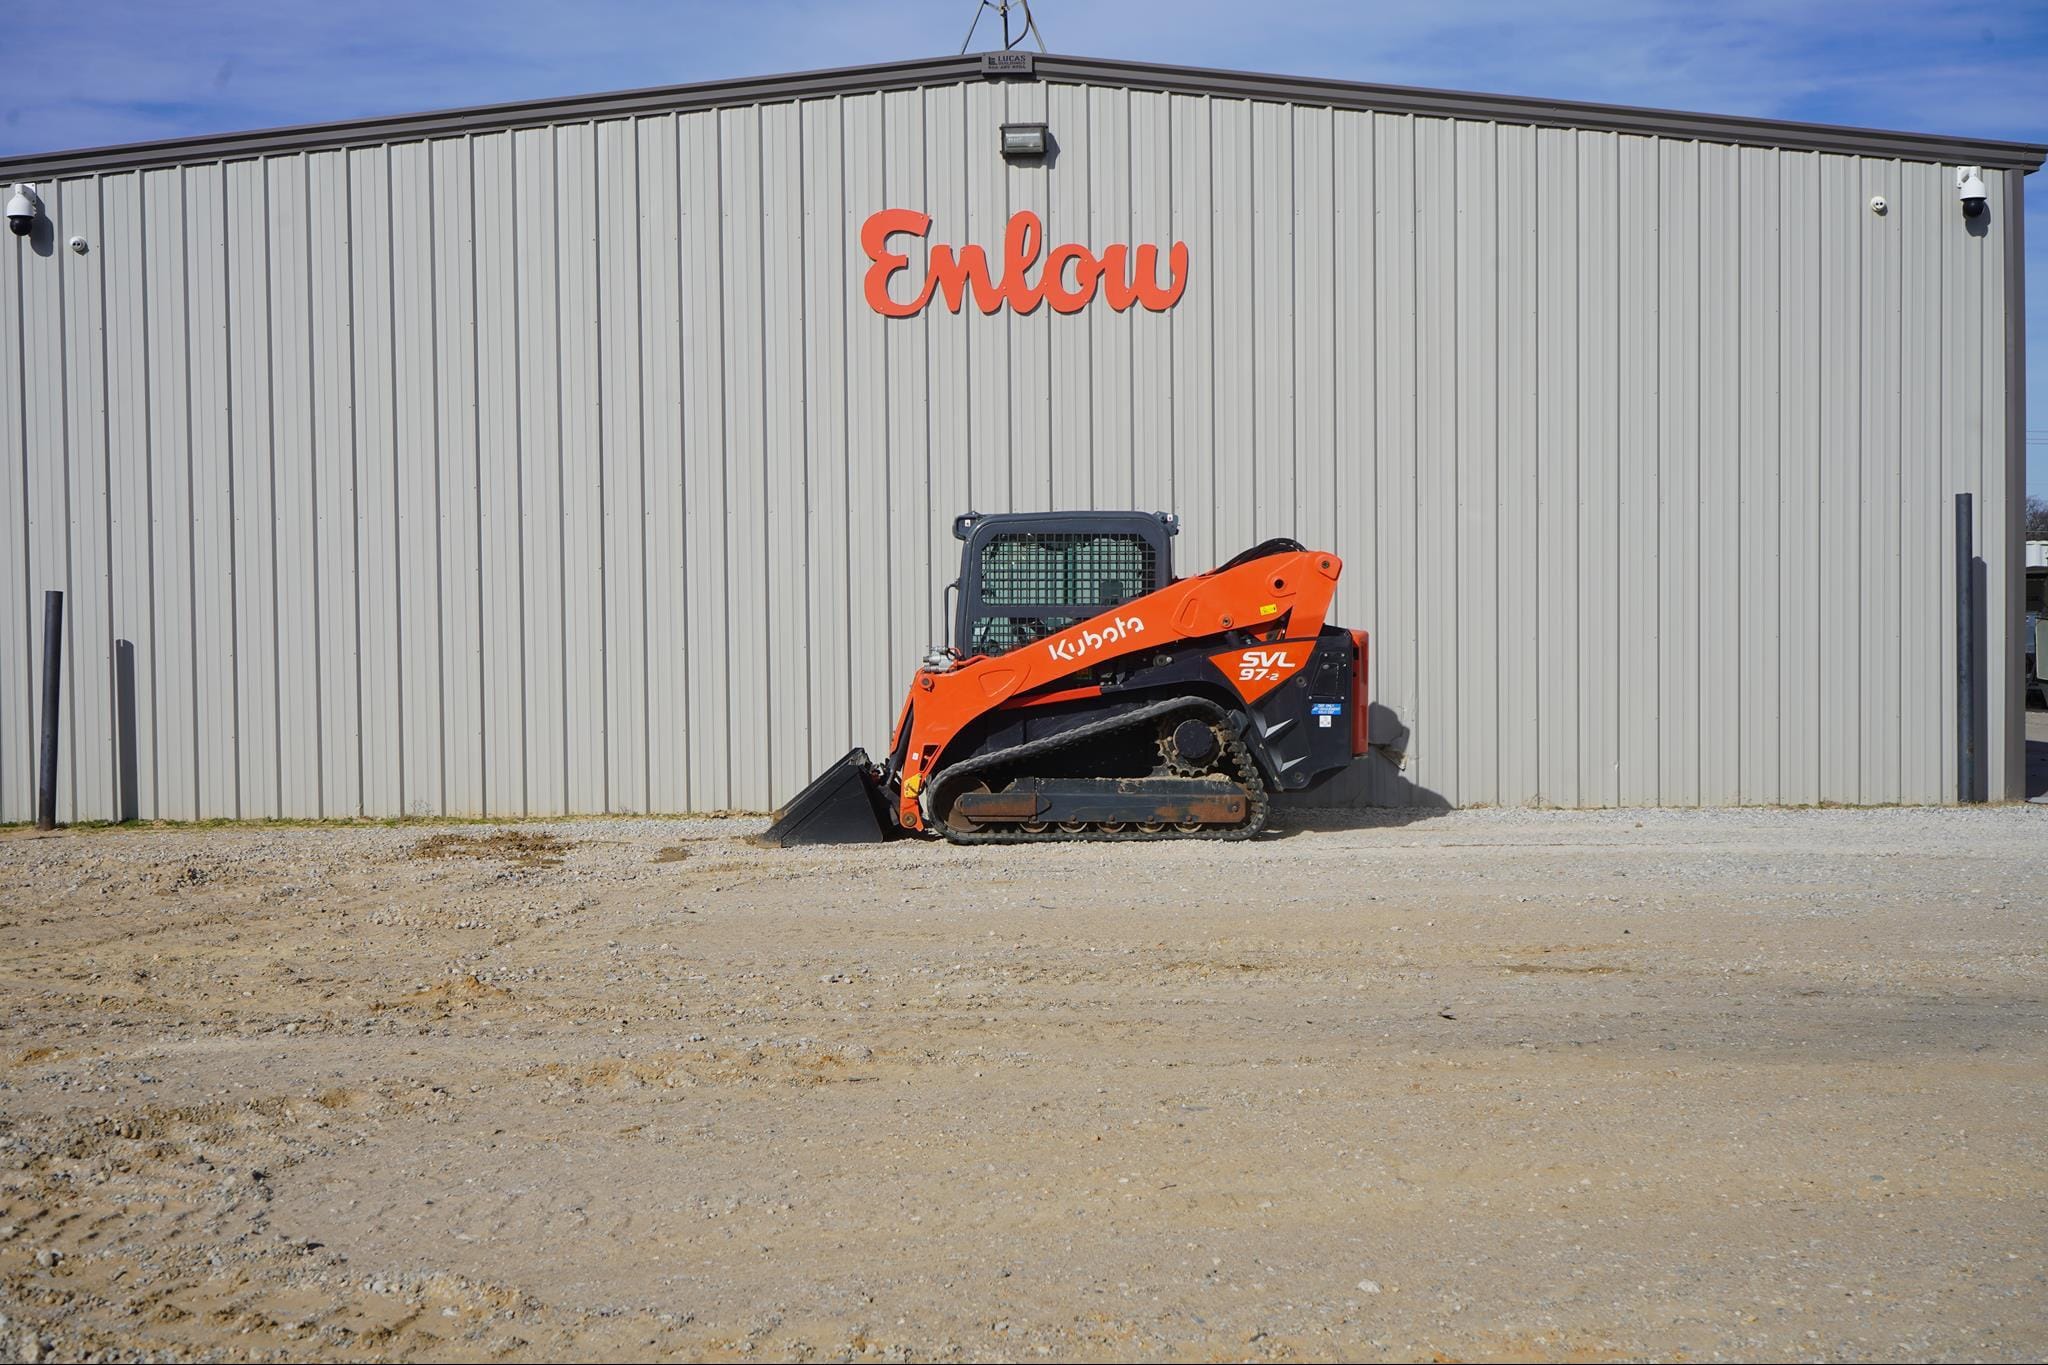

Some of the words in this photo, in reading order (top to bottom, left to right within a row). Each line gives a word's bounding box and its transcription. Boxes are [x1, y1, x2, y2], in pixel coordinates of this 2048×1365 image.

[861, 208, 1189, 317] Enlow
[1048, 617, 1144, 661] Kubota
[1239, 651, 1296, 668] SVL
[1239, 668, 1279, 681] 97-2
